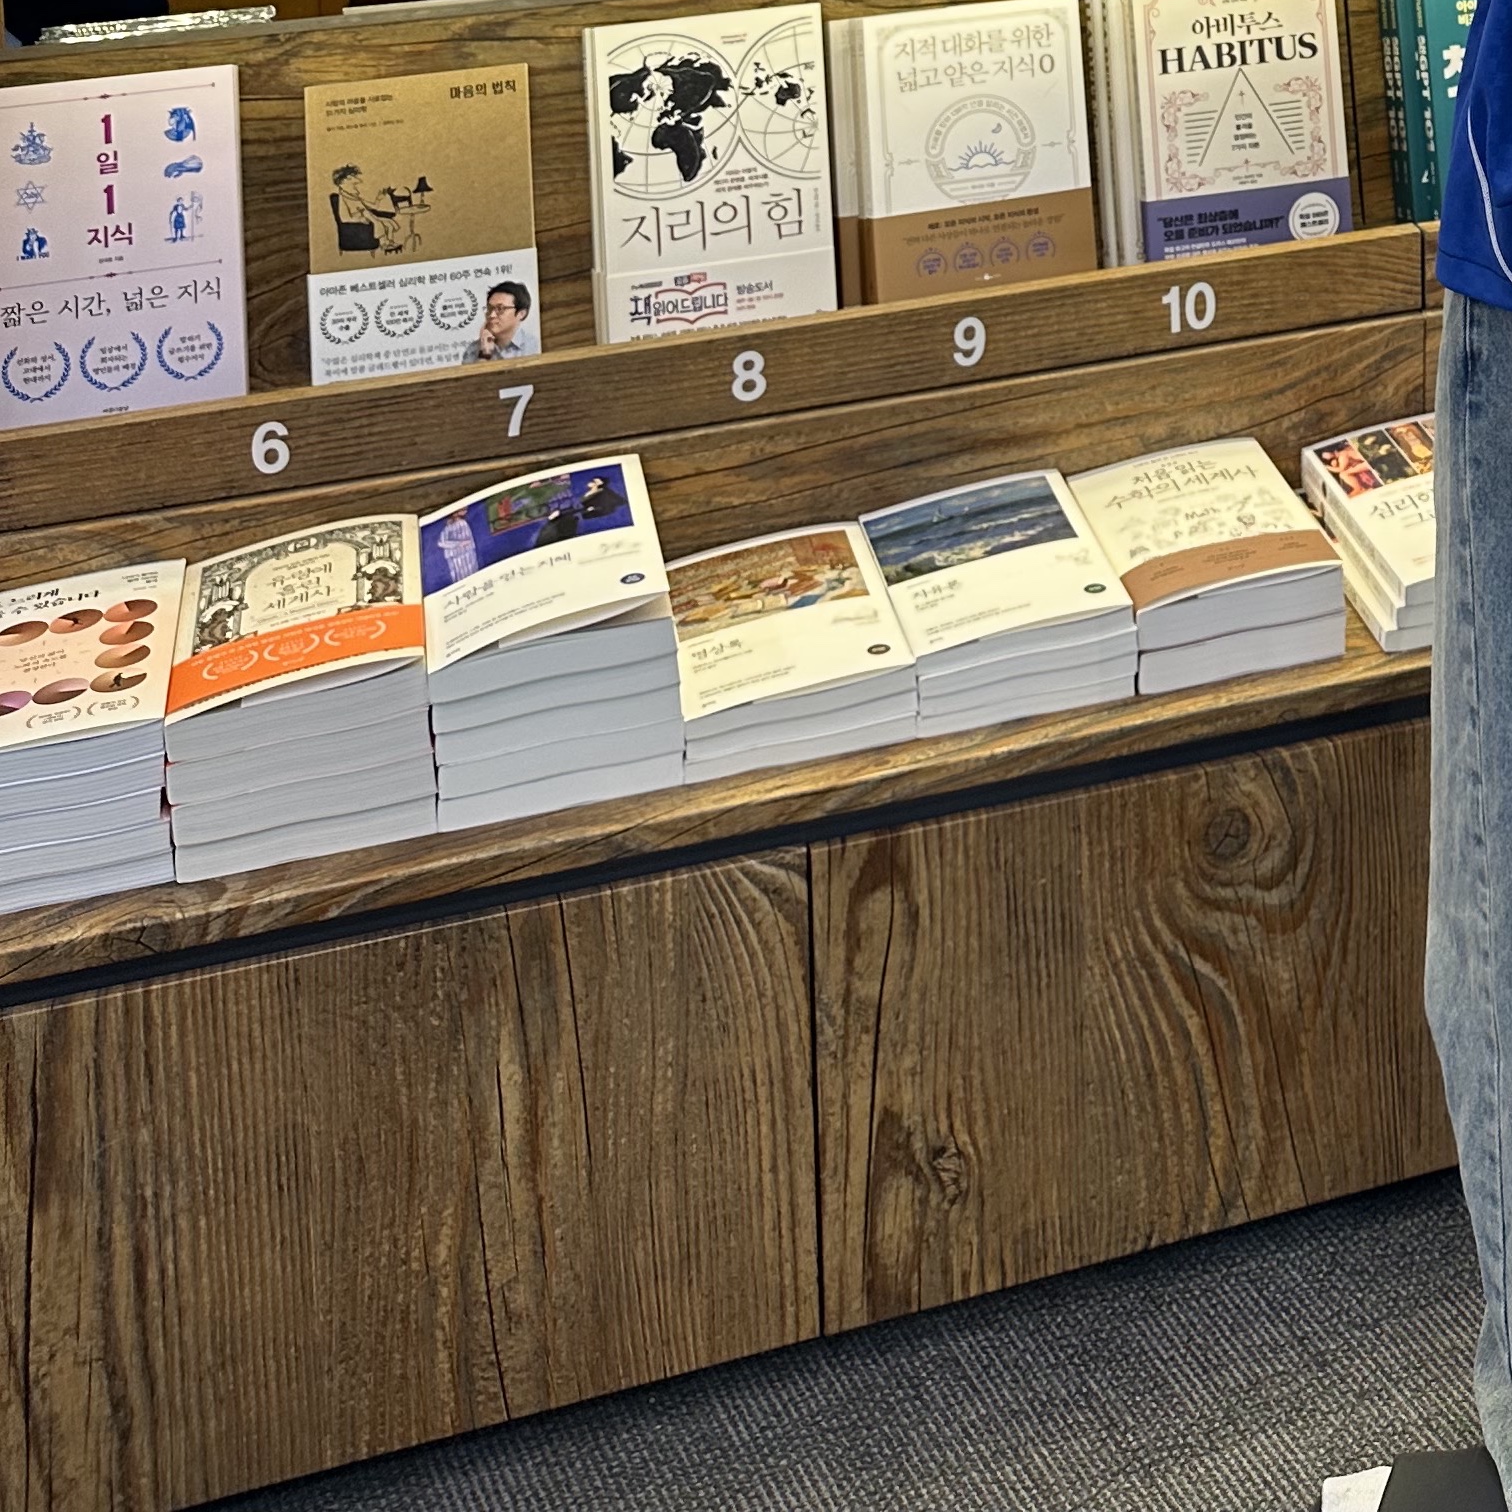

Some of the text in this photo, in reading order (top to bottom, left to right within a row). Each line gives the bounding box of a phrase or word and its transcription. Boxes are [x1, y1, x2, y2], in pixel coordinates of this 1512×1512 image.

[893, 35, 936, 63] 지적
[1008, 22, 1054, 49] 위한
[1191, 10, 1284, 39] 아비투스
[896, 53, 1055, 94] 넓고 얕은 지식 0
[1158, 32, 1319, 76] HABITUS
[449, 79, 517, 100] 마음의 법칙
[100, 113, 114, 145] 1
[96, 150, 119, 176] 일
[103, 185, 116, 215] 1
[87, 222, 134, 248] 지식
[620, 188, 804, 257] 지리의 힘
[0, 276, 222, 328] 짧은 시간, 넓은 지식
[1161, 281, 1216, 334] 10
[953, 317, 986, 367] 9
[731, 350, 767, 402] 8
[499, 384, 535, 438] 7
[251, 421, 290, 474] 6
[1105, 465, 1258, 510] 수학의 세계사
[1132, 458, 1217, 487] 처음 읽는
